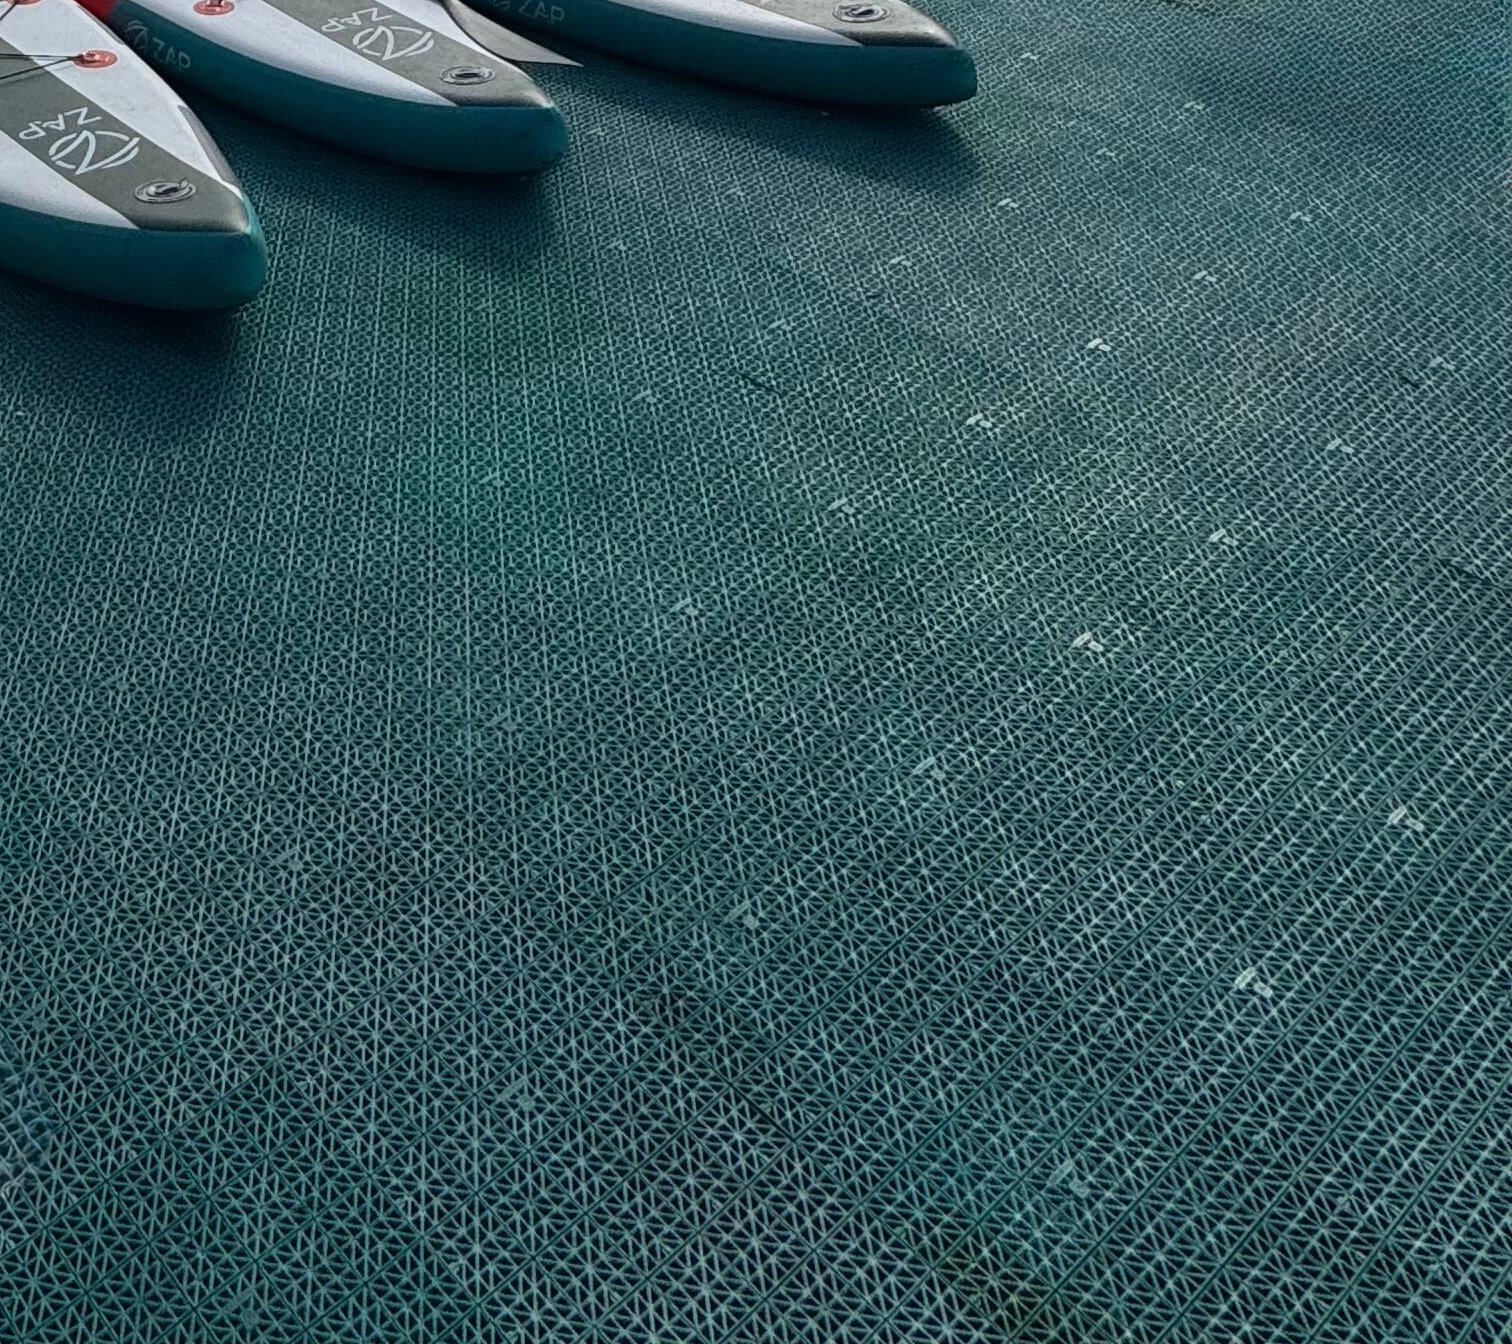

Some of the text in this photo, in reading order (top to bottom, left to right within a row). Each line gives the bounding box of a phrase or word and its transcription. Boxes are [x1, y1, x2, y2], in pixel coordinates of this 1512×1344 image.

[320, 6, 393, 33] ZAP
[152, 36, 192, 72] ZAP
[18, 106, 104, 141] ZAP
